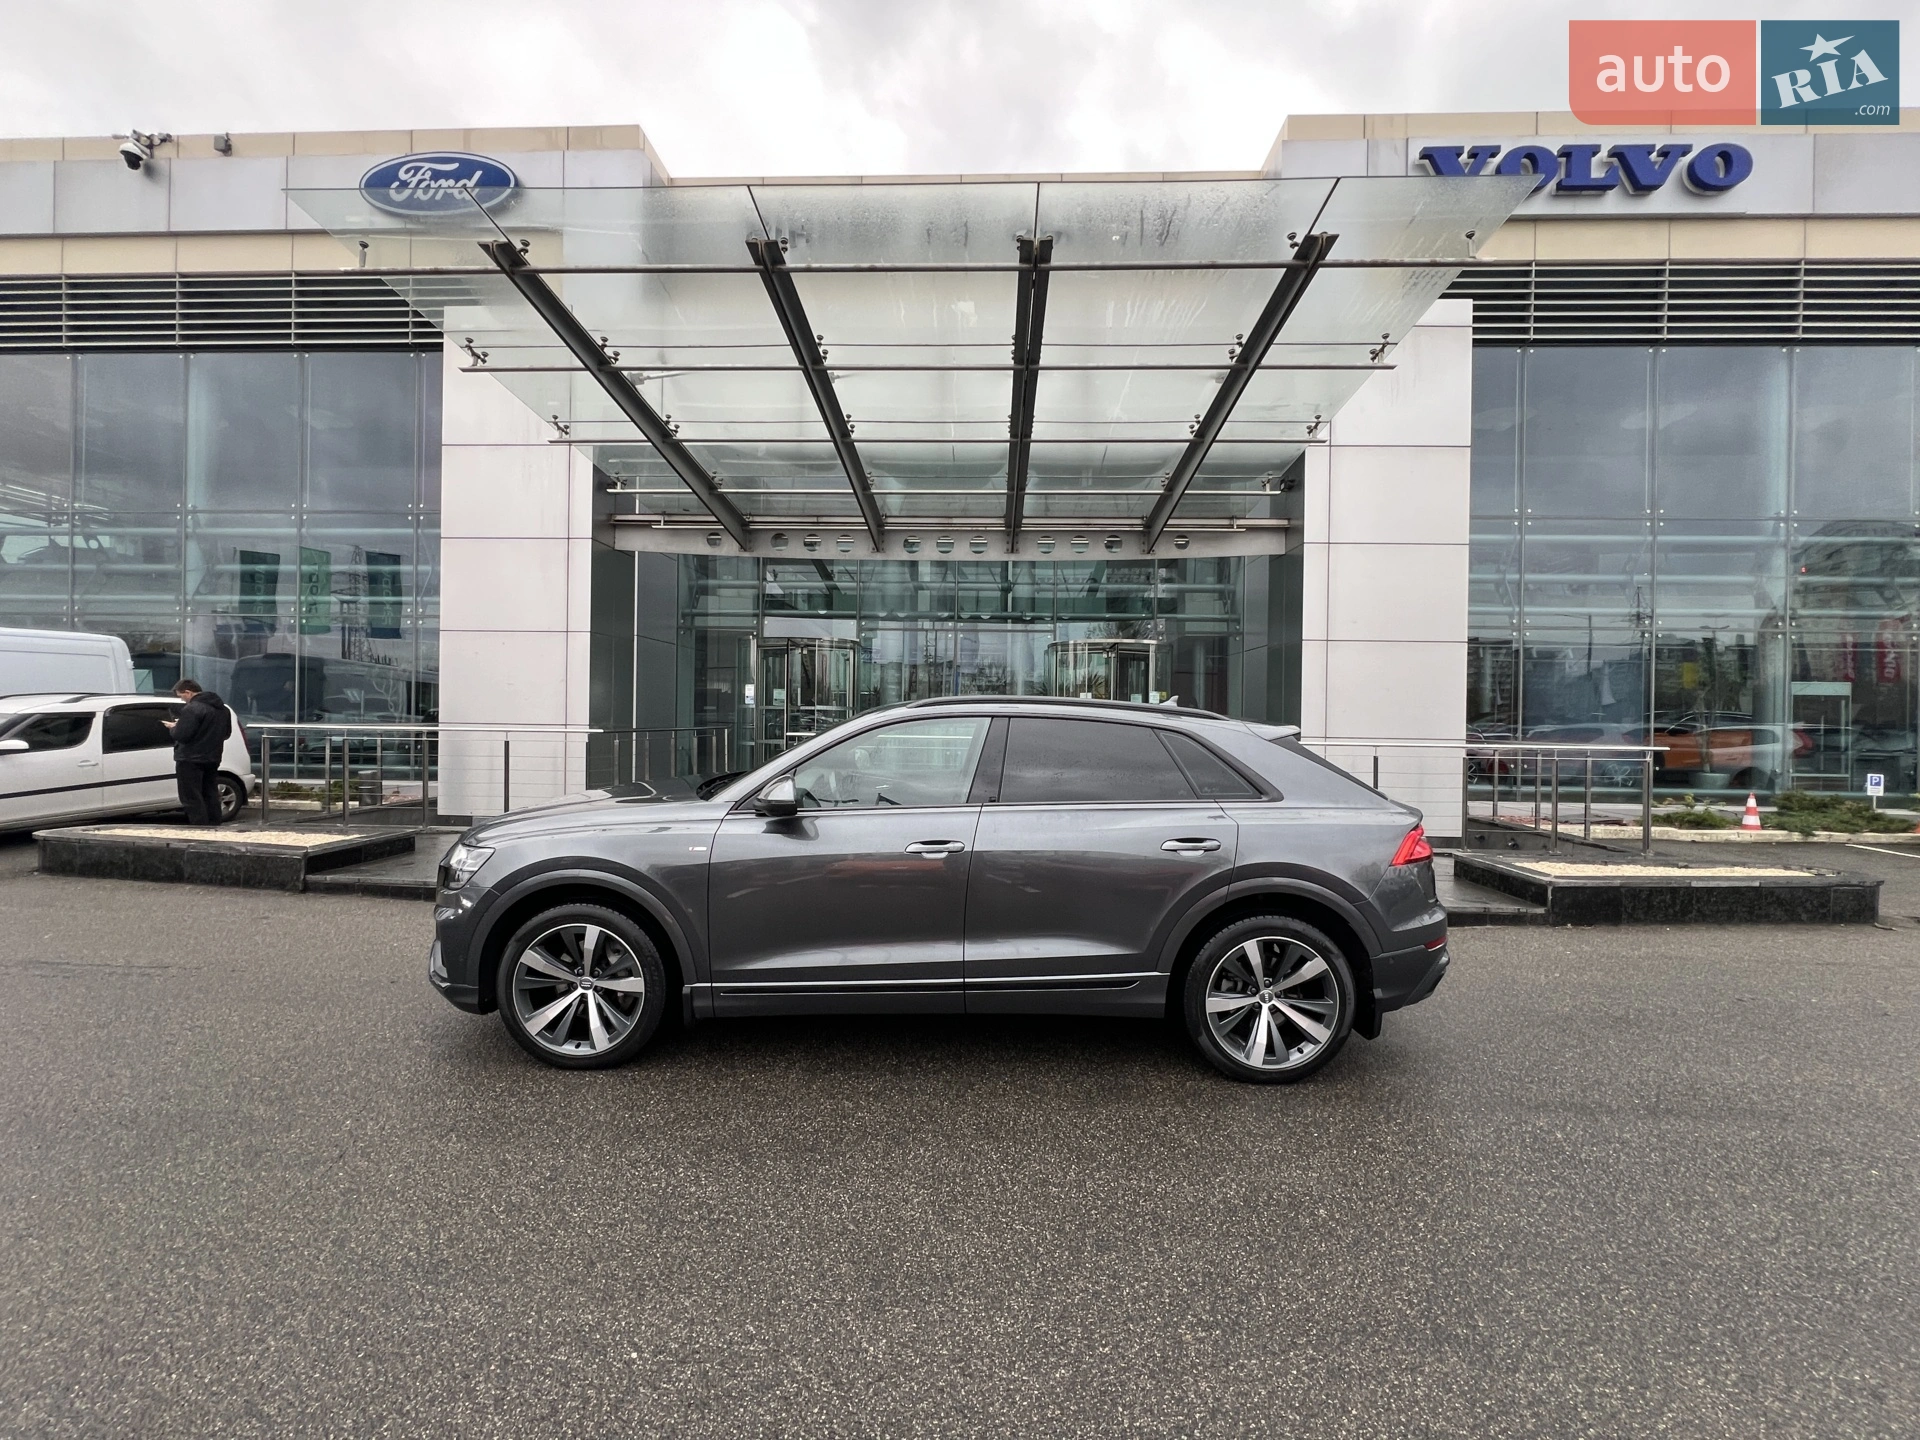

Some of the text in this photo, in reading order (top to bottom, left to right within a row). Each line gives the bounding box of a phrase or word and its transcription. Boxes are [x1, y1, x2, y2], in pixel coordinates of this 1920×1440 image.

[389, 162, 482, 202] Ford
[1418, 143, 1754, 192] VOLVO
[1872, 776, 1880, 786] P
